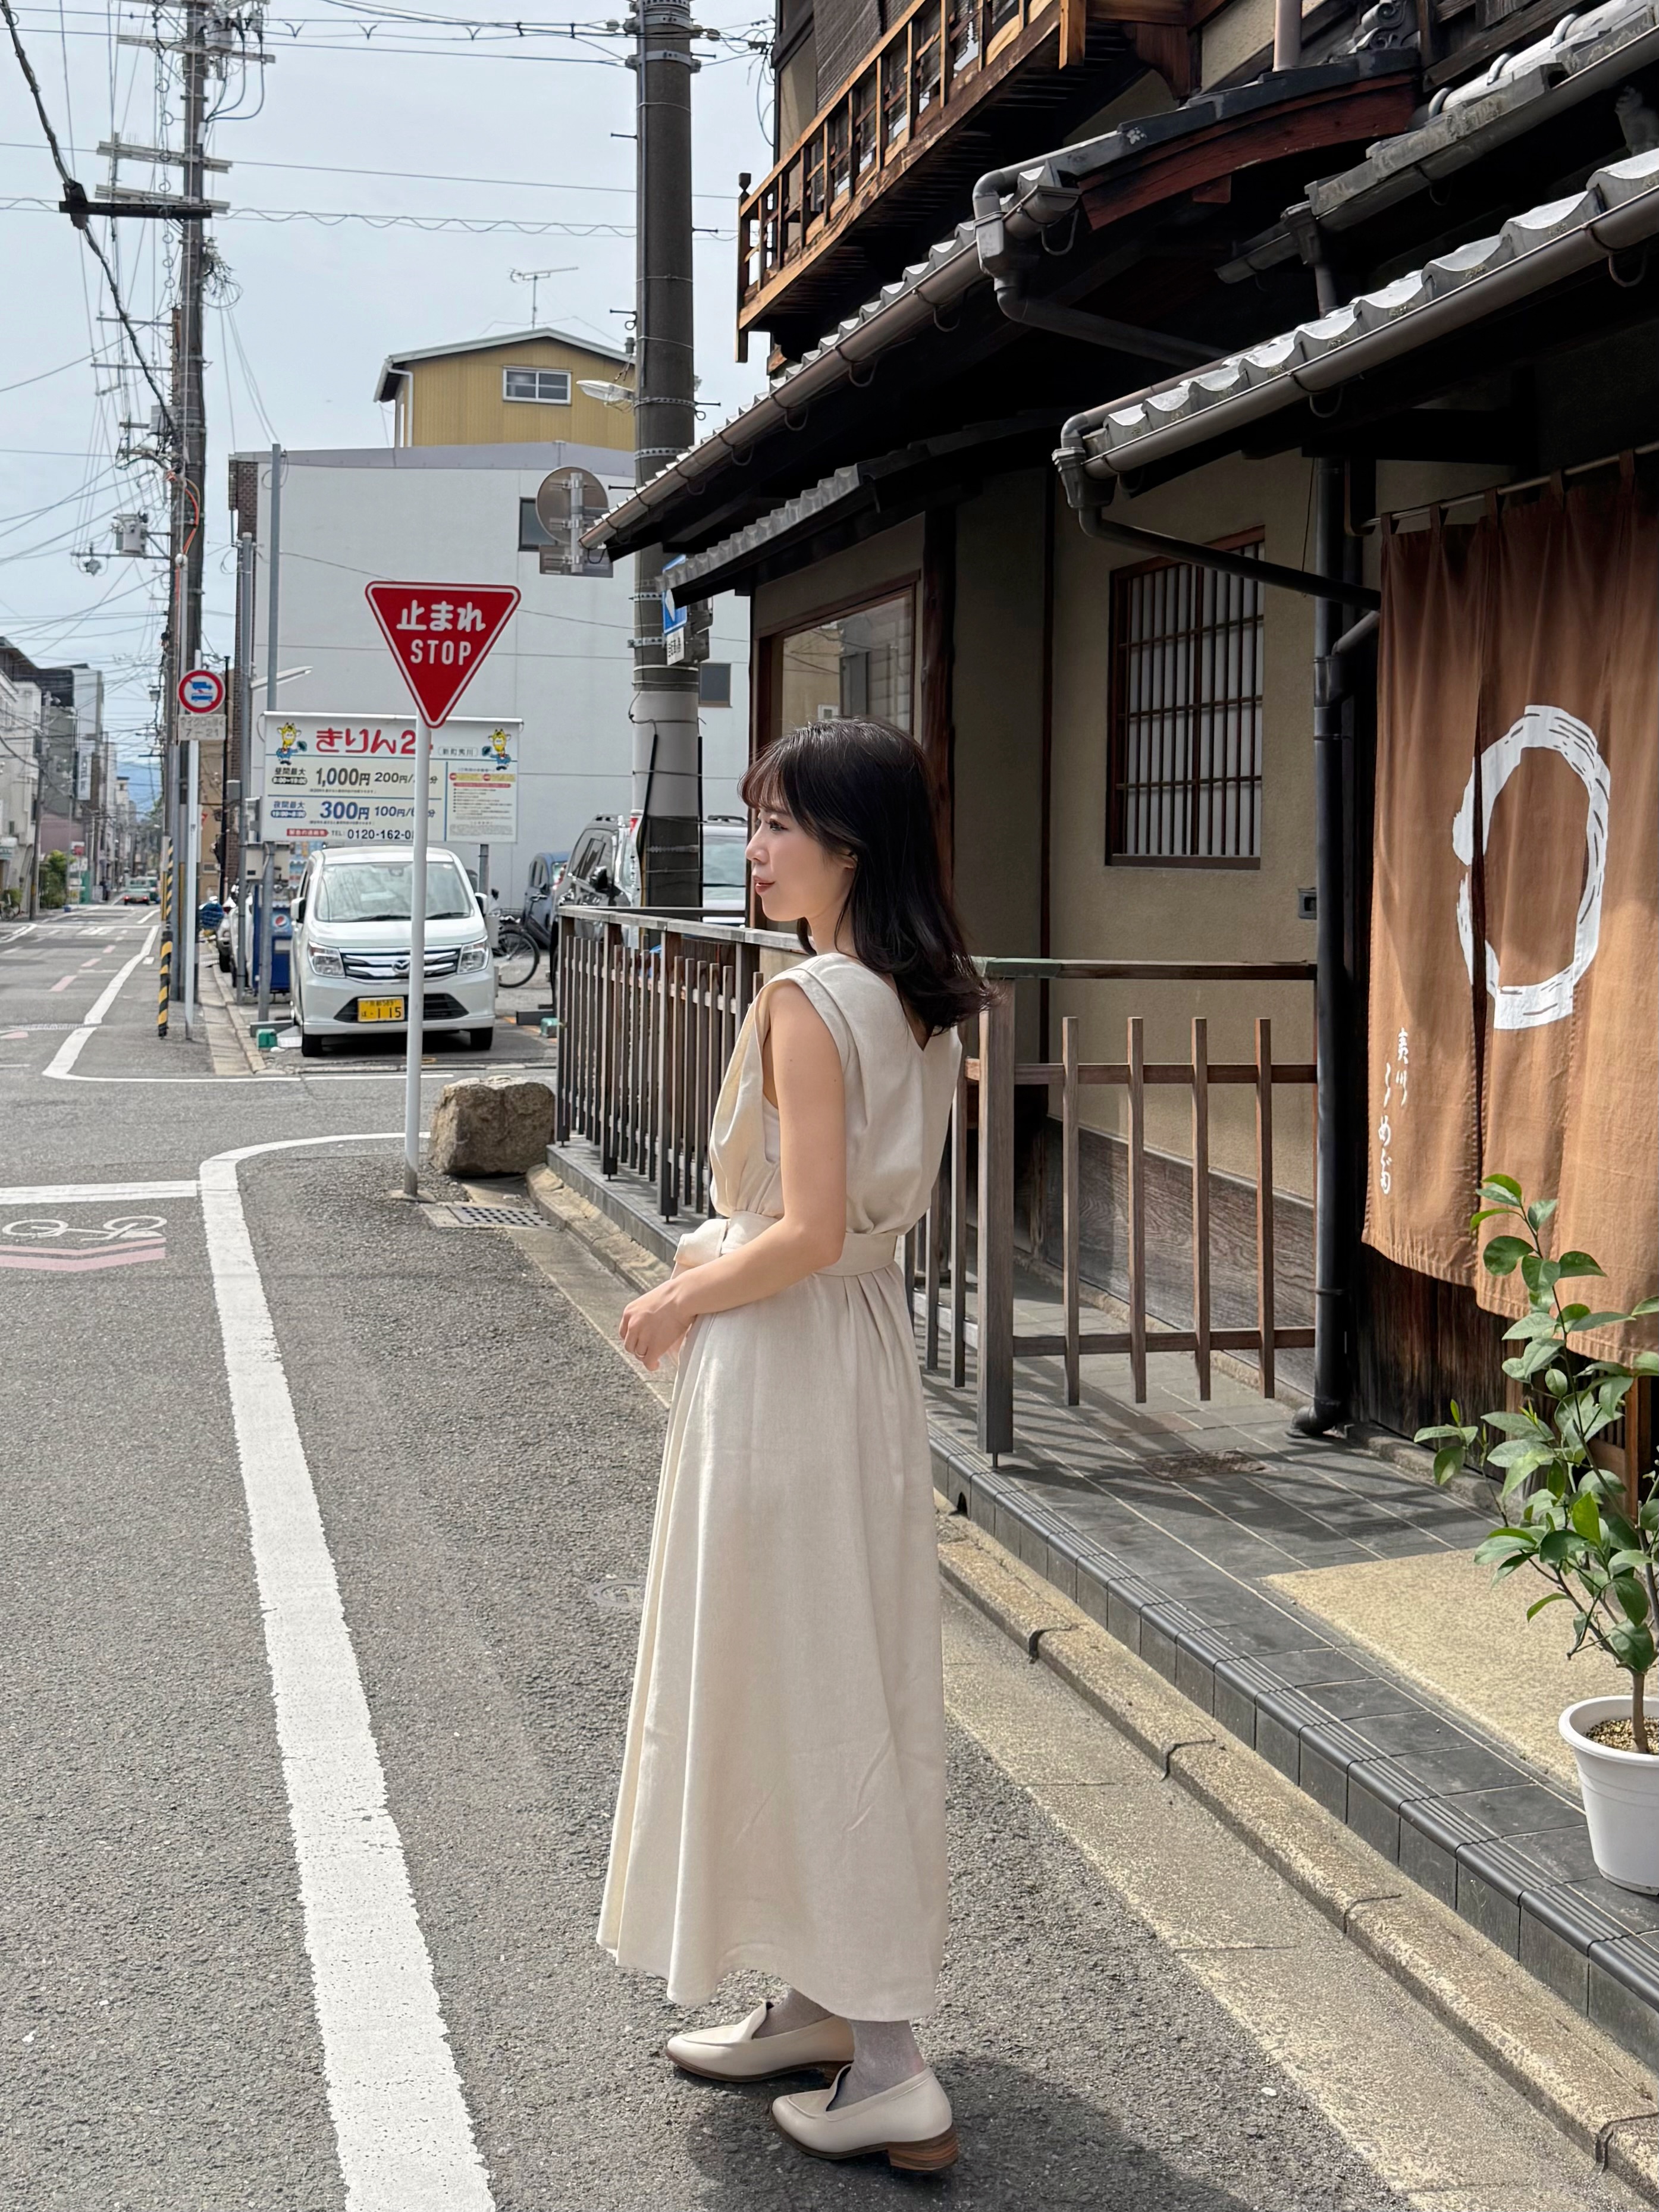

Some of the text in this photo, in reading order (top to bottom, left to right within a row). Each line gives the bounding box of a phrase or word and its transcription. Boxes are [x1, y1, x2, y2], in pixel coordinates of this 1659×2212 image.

[397, 600, 486, 632] 止まれ
[410, 639, 471, 665] STOP
[316, 727, 433, 754] きりん2
[316, 767, 370, 788] 1,000円
[320, 801, 370, 820] 300円
